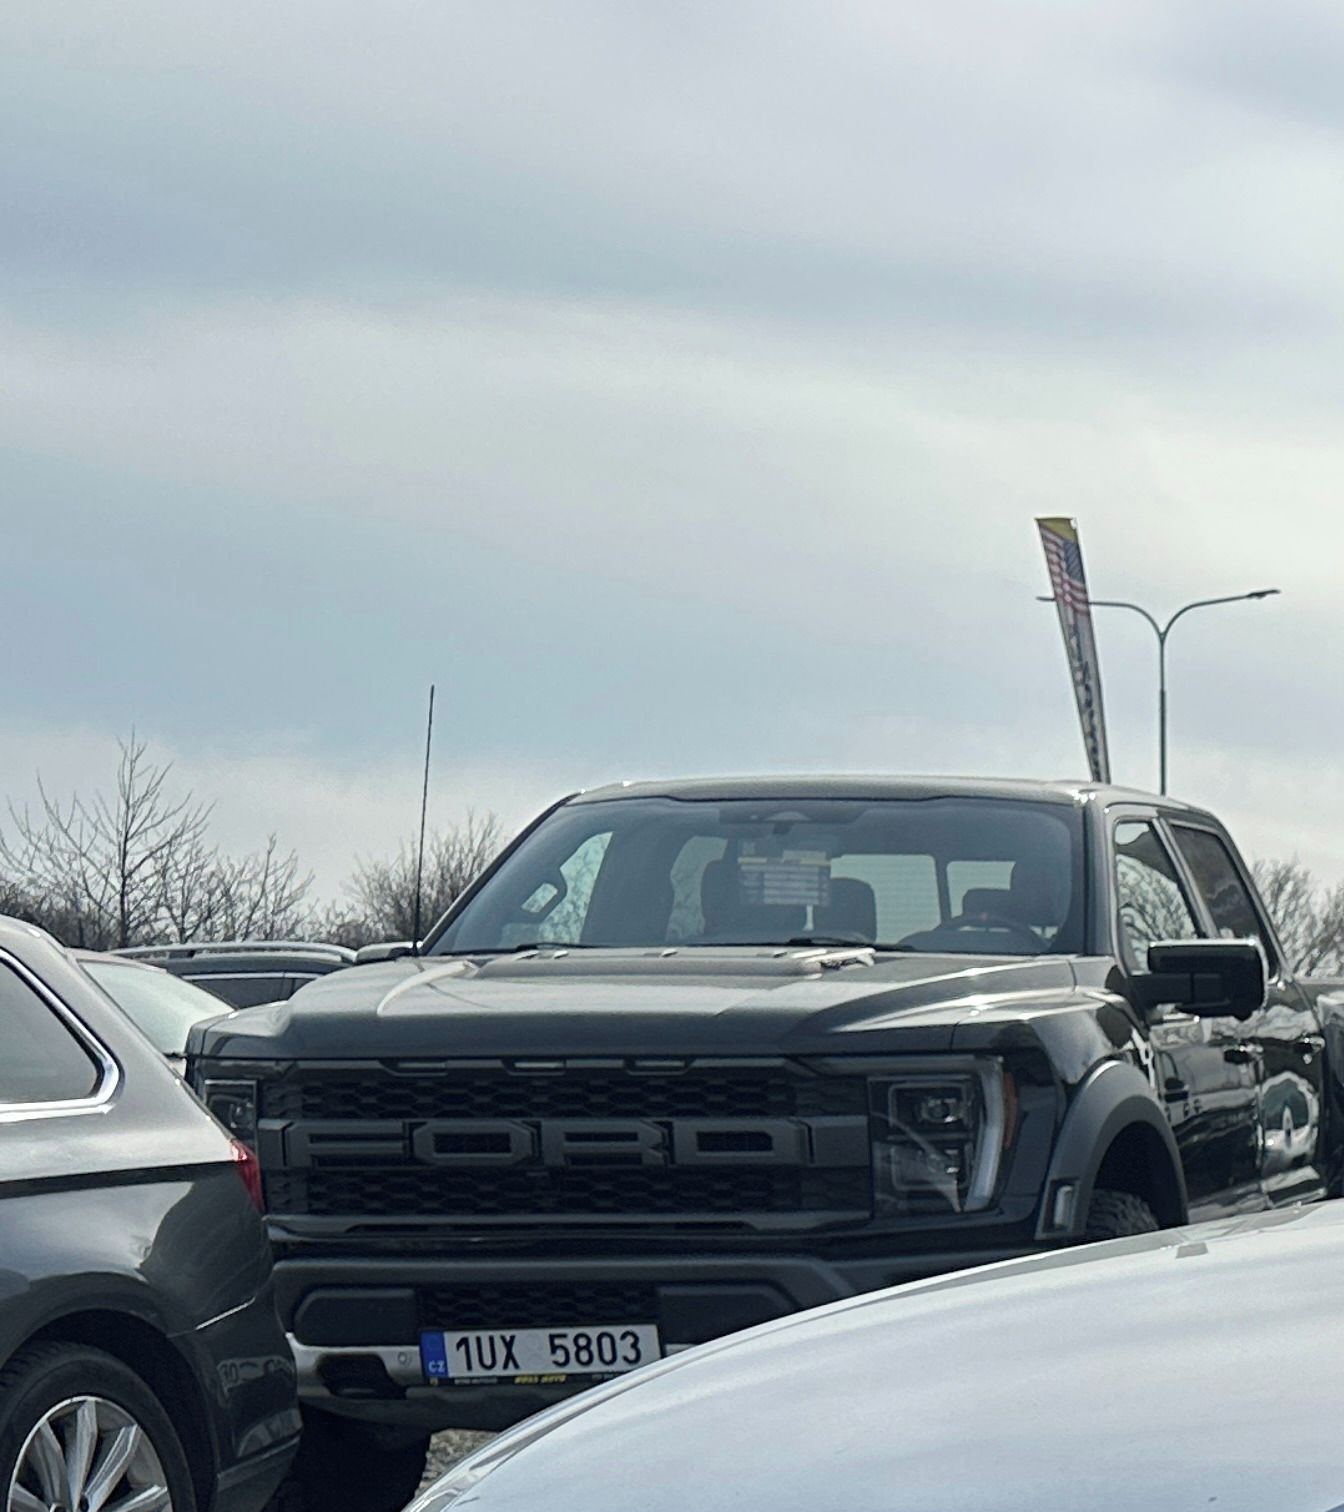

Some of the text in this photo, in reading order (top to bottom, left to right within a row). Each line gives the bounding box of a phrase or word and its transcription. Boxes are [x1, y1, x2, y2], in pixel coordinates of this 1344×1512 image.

[291, 1117, 808, 1168] FORD
[428, 1360, 447, 1374] CZ
[456, 1330, 643, 1372] 1UX 5803
